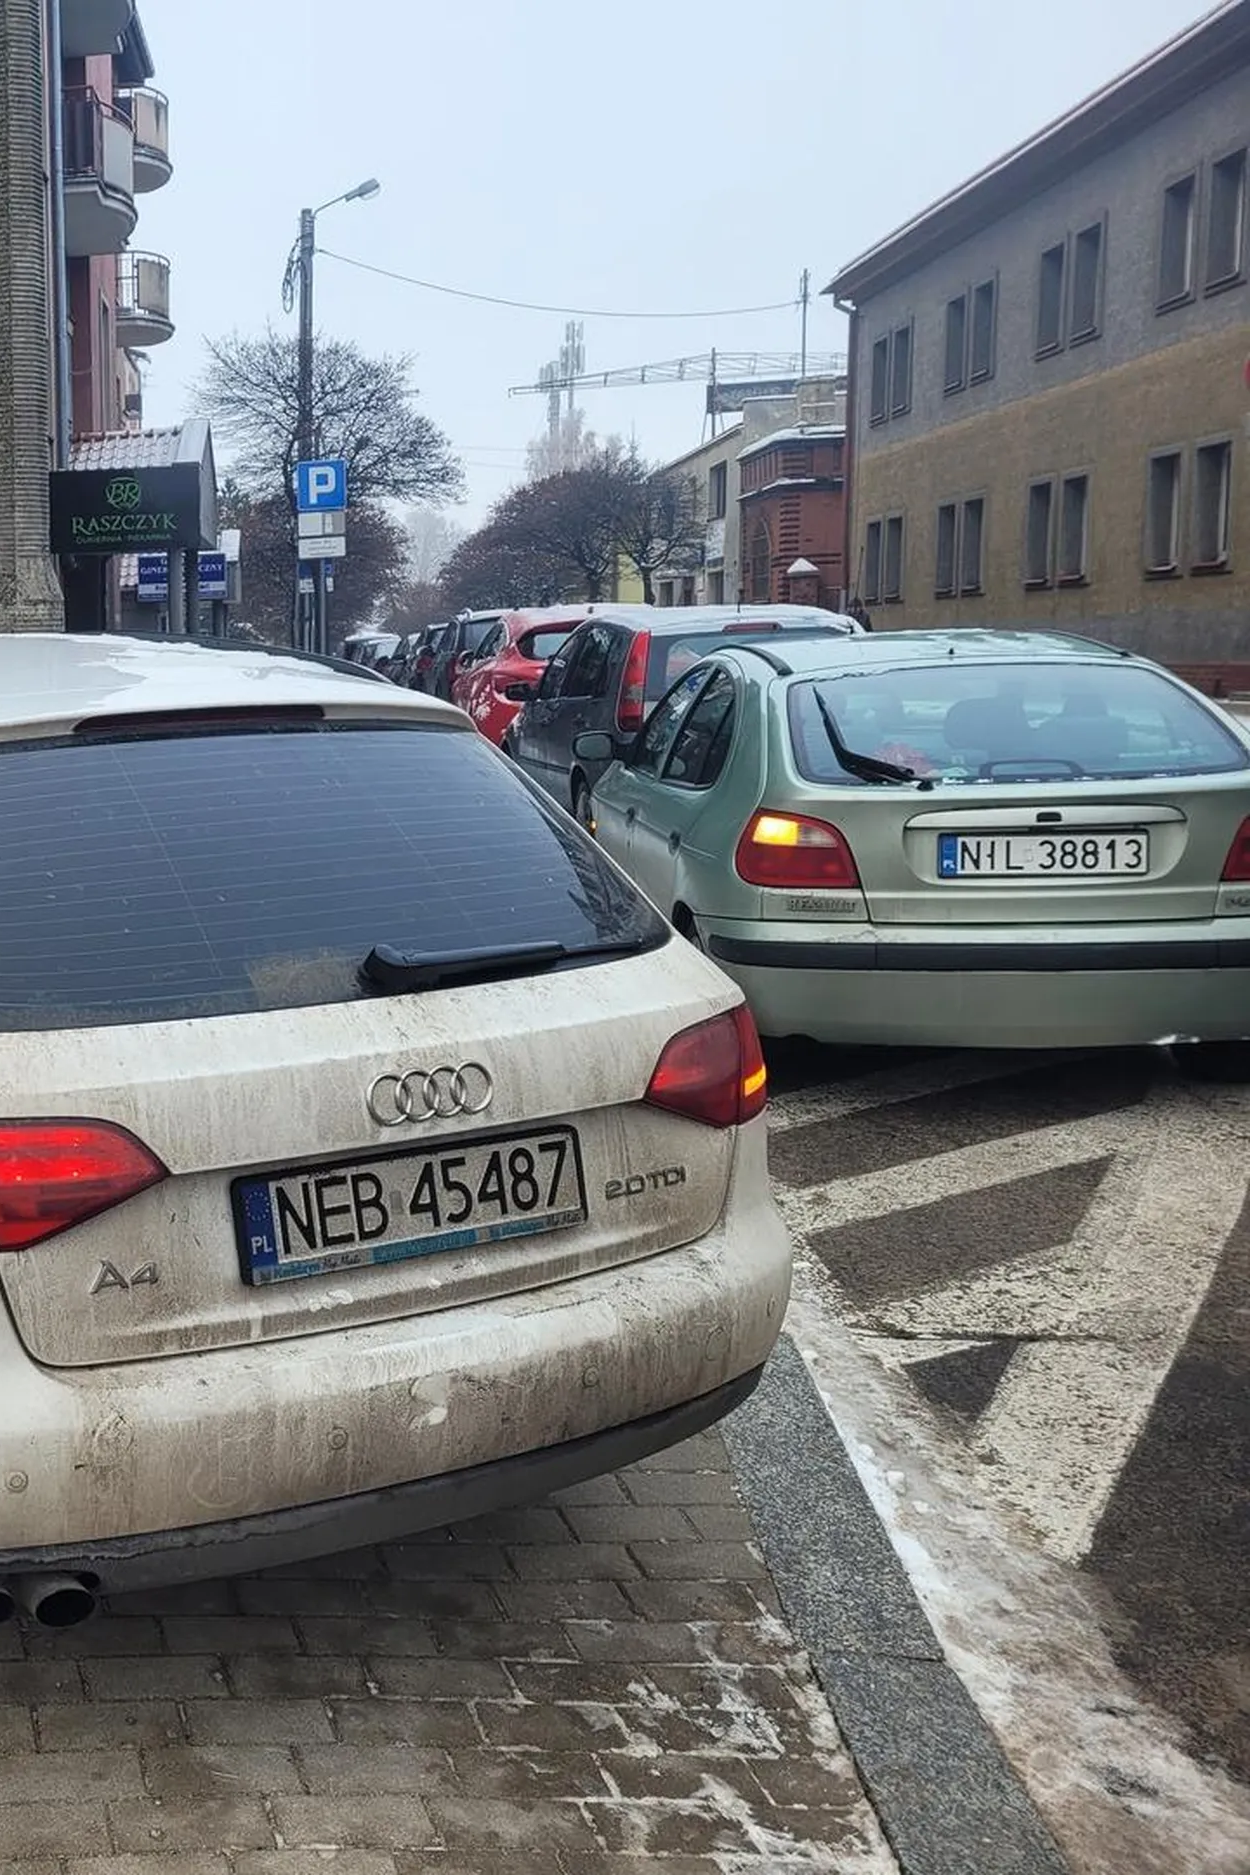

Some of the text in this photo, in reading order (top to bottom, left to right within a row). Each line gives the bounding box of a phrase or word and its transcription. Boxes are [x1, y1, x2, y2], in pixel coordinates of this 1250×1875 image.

[308, 465, 336, 505] P
[71, 513, 178, 536] RASZCZYK
[960, 840, 1025, 871] NIL
[1038, 838, 1143, 870] 38813
[274, 1171, 390, 1256] NEB
[408, 1138, 569, 1230] 45487
[250, 1234, 273, 1256] PL
[88, 1259, 159, 1295] A4
